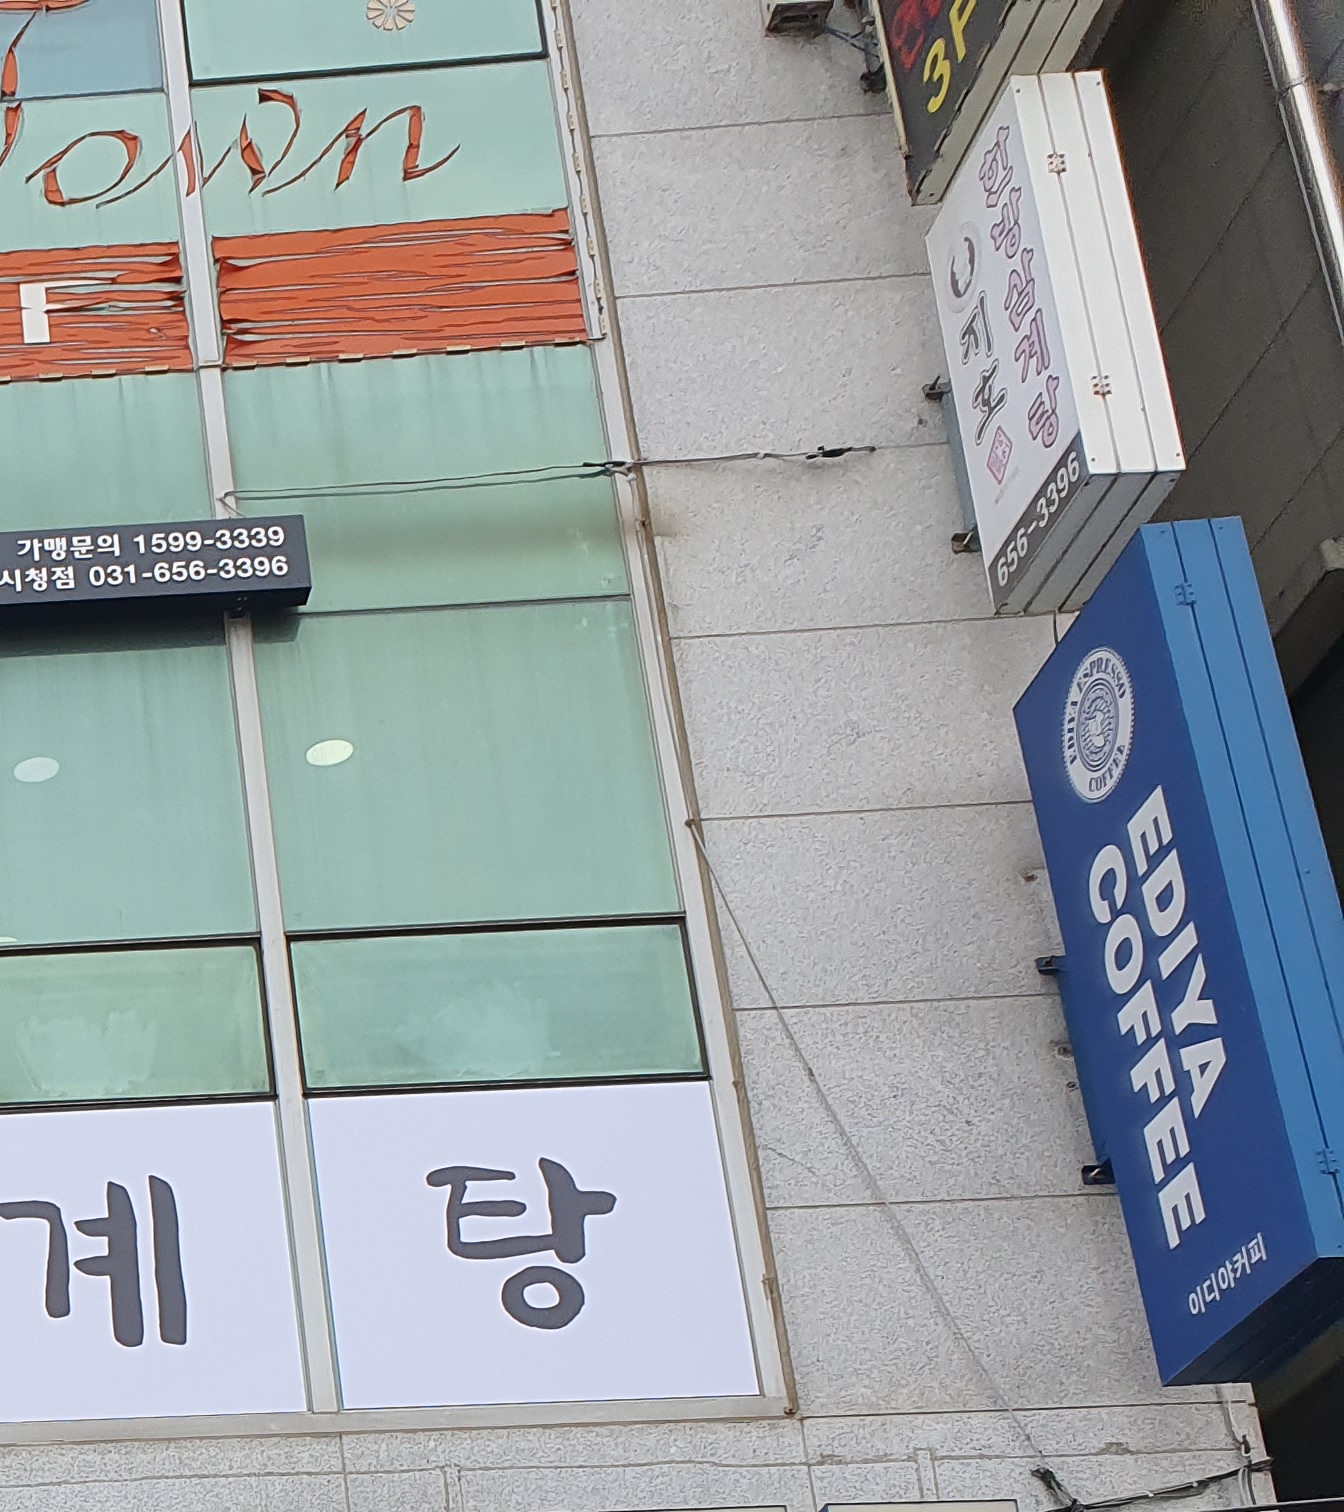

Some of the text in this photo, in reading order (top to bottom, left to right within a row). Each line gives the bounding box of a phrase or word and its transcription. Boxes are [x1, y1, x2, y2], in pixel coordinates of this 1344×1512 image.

[979, 126, 1059, 449] 한방삼계탕
[960, 291, 1008, 446] 지호
[16, 526, 286, 562] 가맹문의 1599-3339
[88, 555, 289, 588] 031-656-3396
[996, 450, 1080, 589] 656-3396
[1127, 784, 1227, 1120] EDIYA
[1089, 844, 1206, 1251] COFFEE
[1188, 1231, 1267, 1316] 이디야커피
